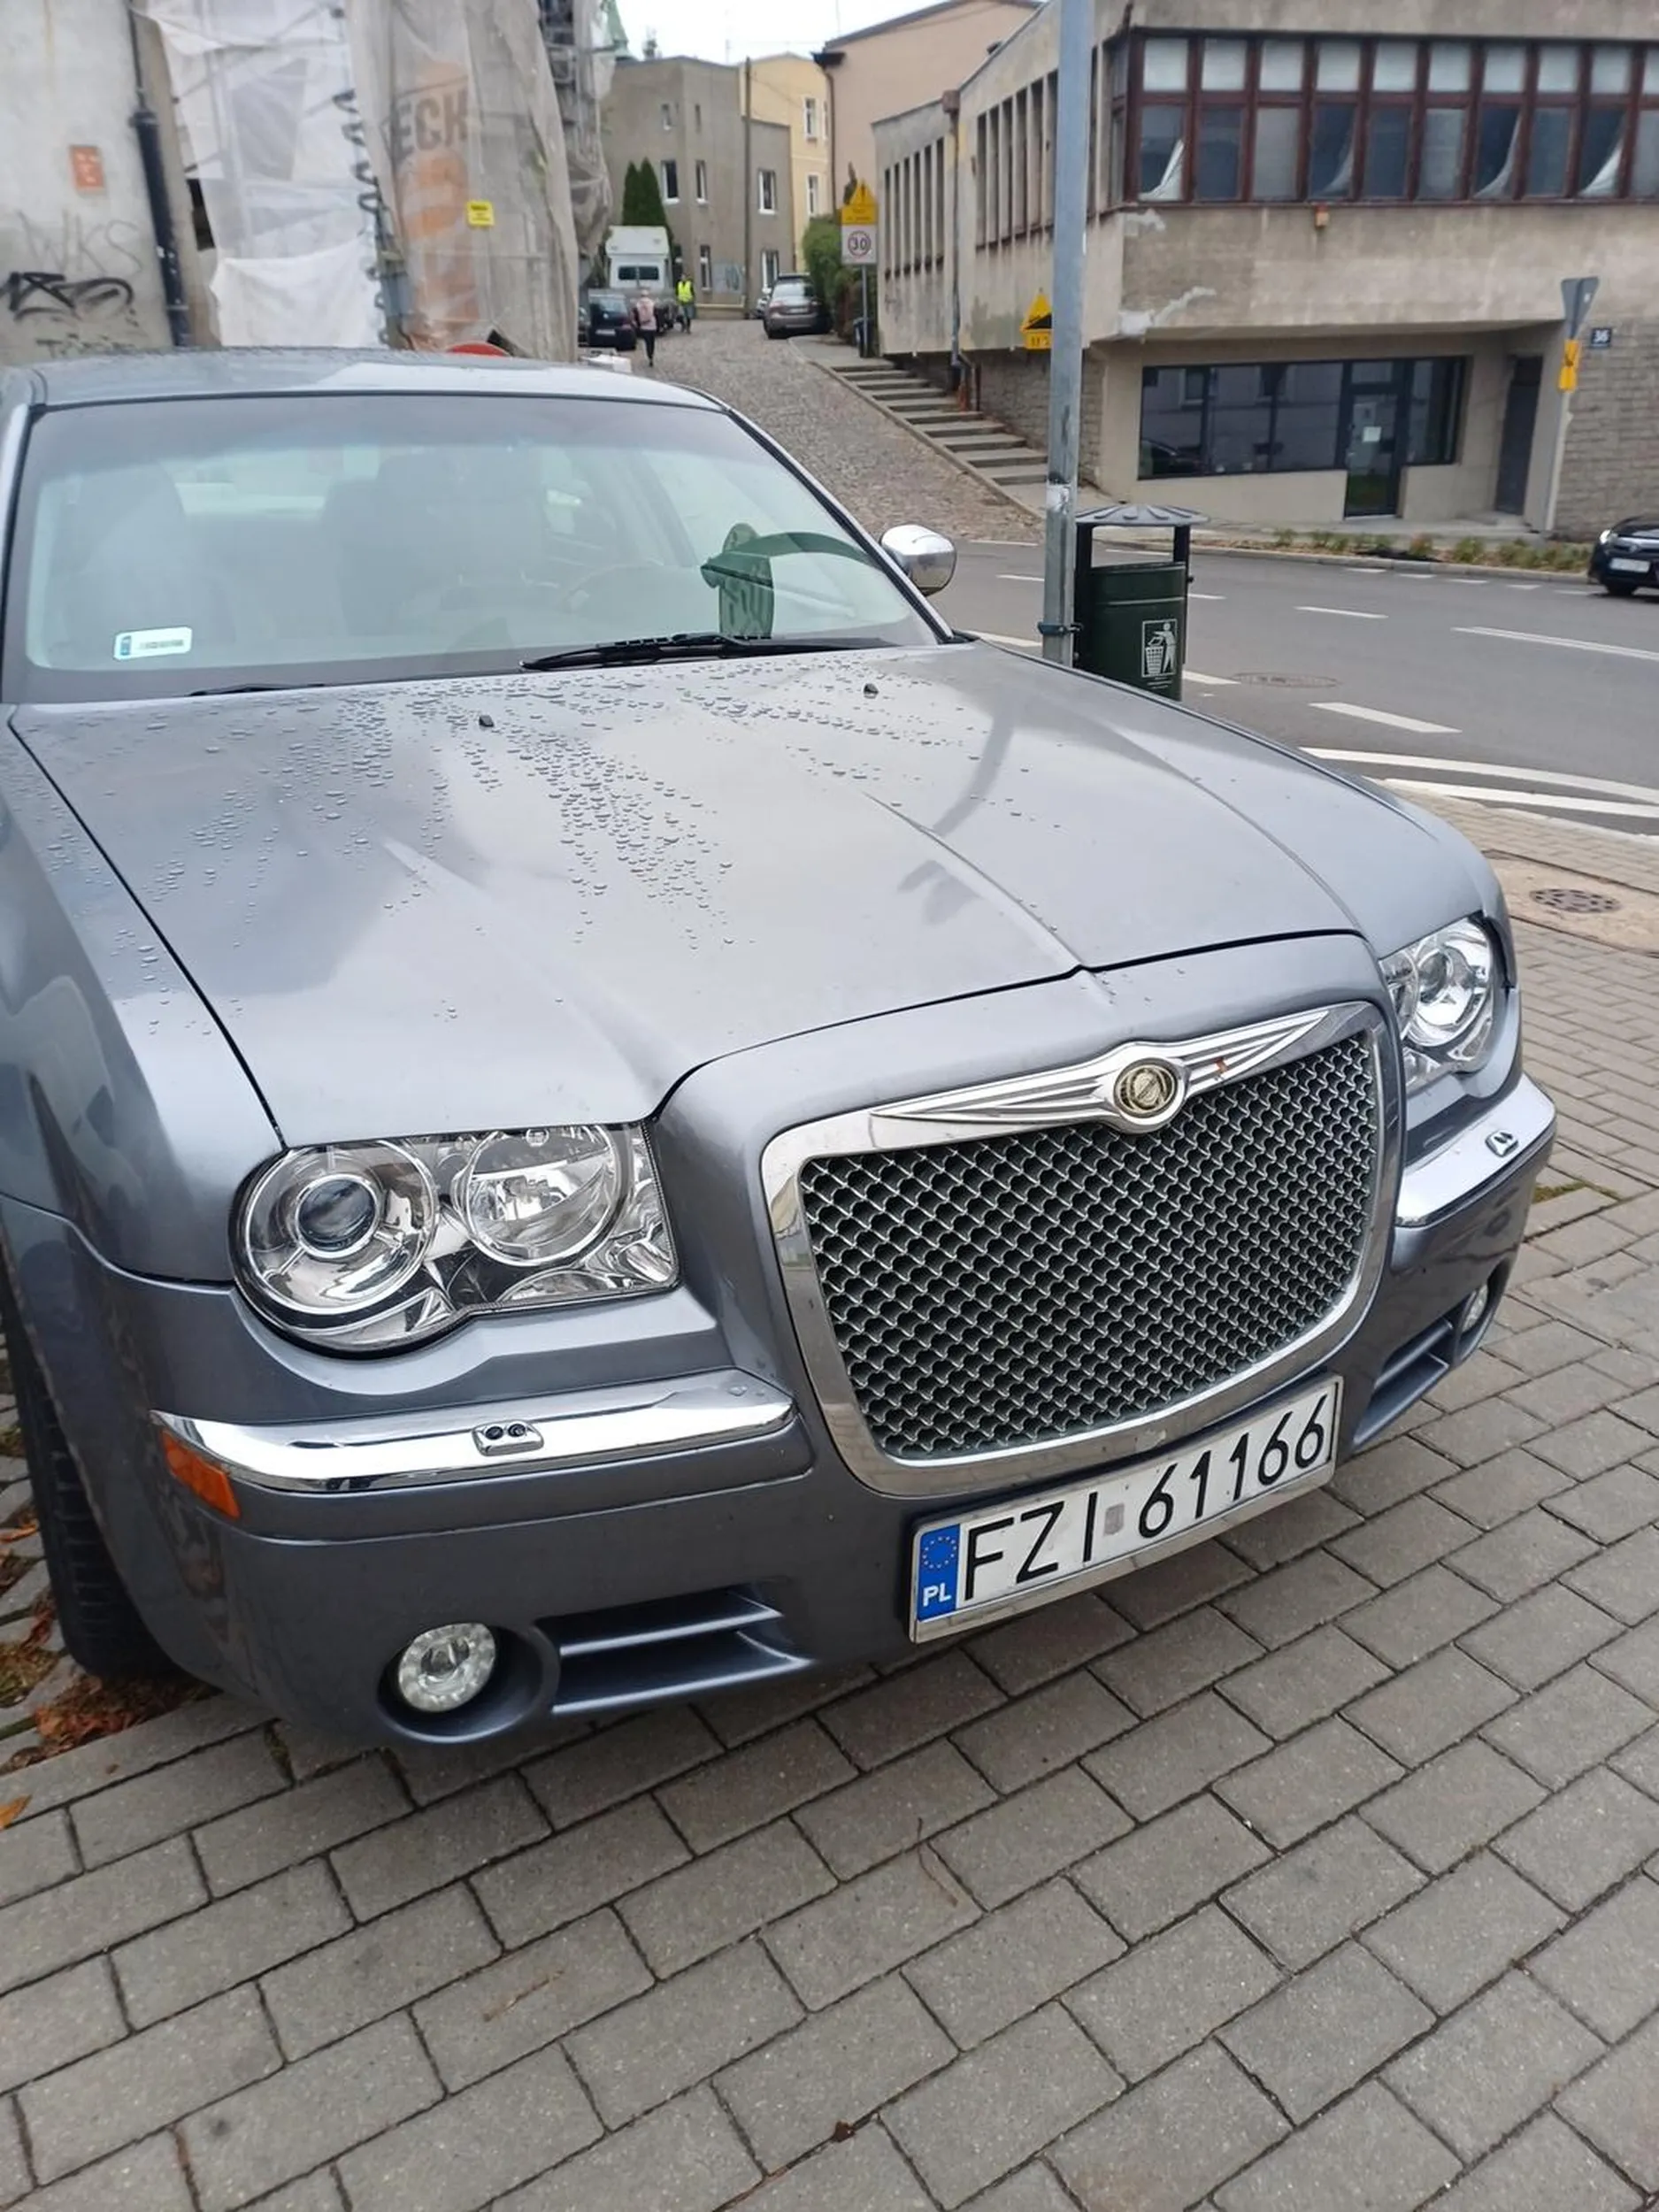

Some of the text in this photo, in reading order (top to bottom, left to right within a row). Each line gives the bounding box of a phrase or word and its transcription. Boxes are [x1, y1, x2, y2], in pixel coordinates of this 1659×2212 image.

[849, 236, 868, 250] 30
[964, 1394, 1328, 1601] FZI 61166
[922, 1582, 952, 1607] PL
